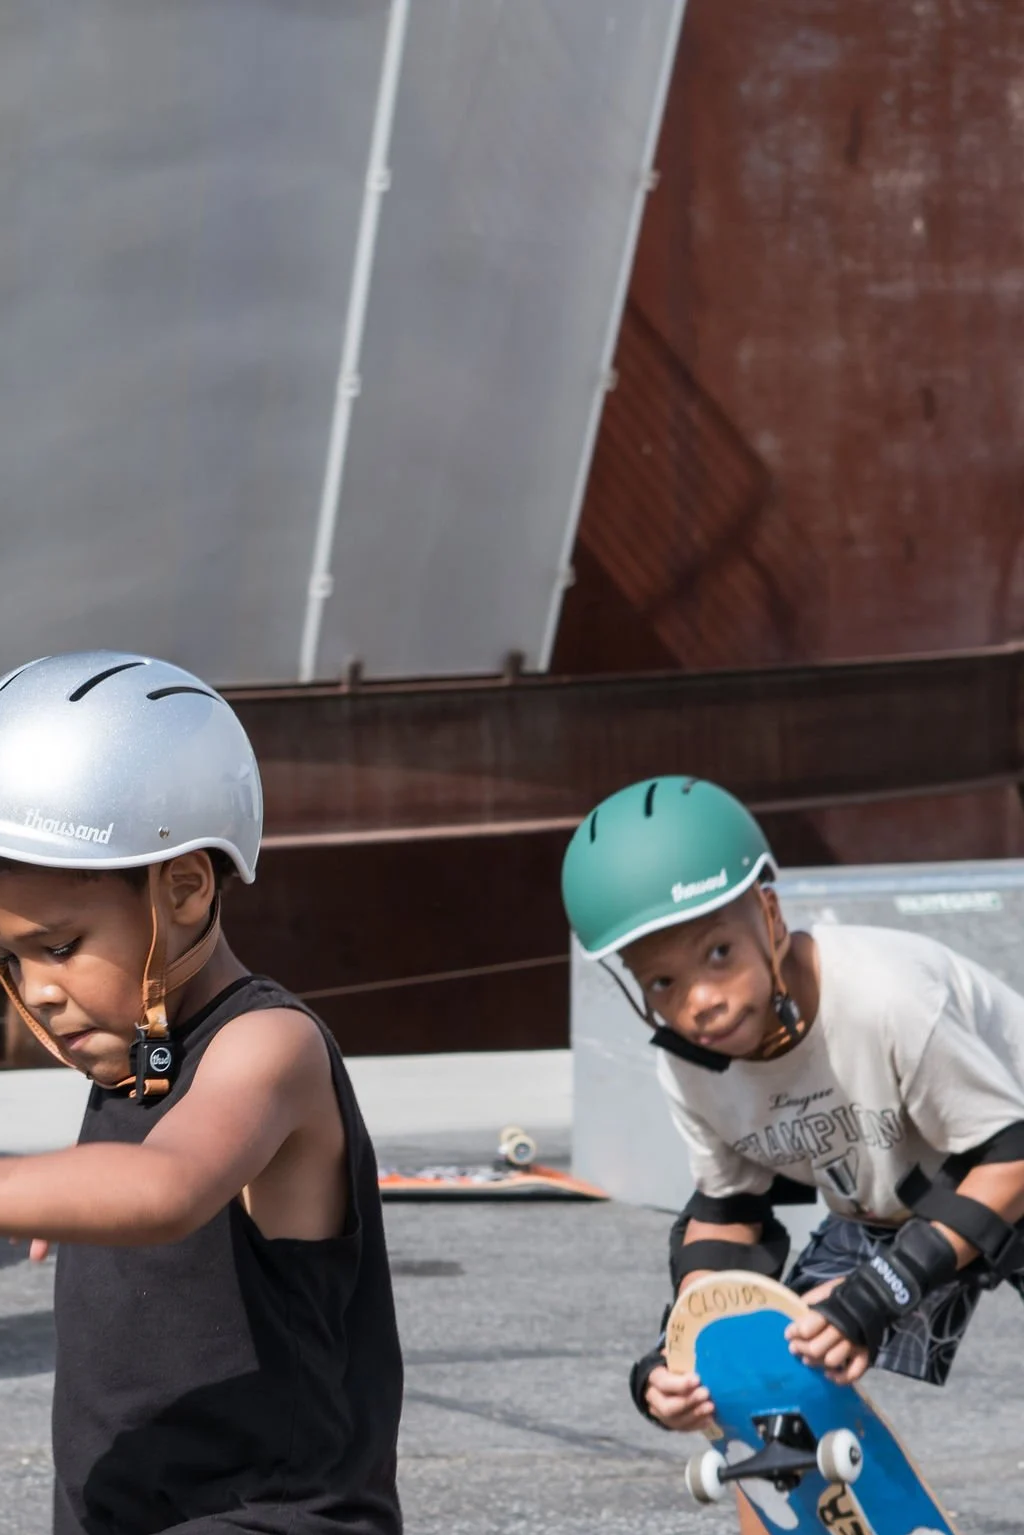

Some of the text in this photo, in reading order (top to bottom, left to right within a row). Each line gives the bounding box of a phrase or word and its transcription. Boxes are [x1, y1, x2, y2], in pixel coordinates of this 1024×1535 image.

[24, 808, 114, 845] thousand
[870, 1255, 910, 1305] Gonex
[688, 1284, 768, 1319] CLOUDS
